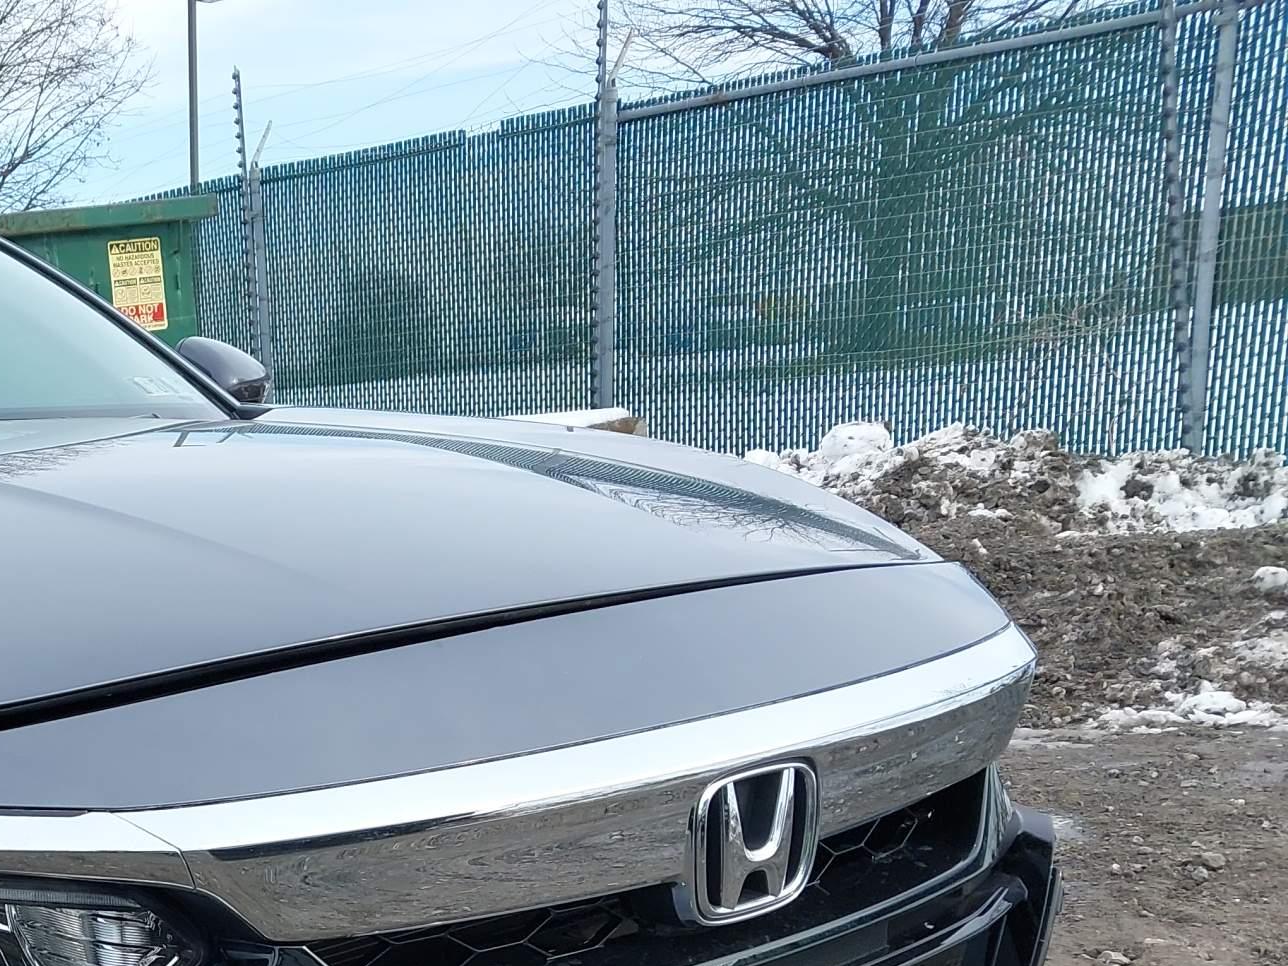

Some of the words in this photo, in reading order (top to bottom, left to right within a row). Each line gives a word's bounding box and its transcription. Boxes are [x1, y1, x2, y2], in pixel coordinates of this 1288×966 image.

[119, 240, 158, 253] CAUTION
[125, 253, 154, 261] HAZARDOUS
[120, 306, 136, 316] DO
[138, 303, 159, 314] NOT
